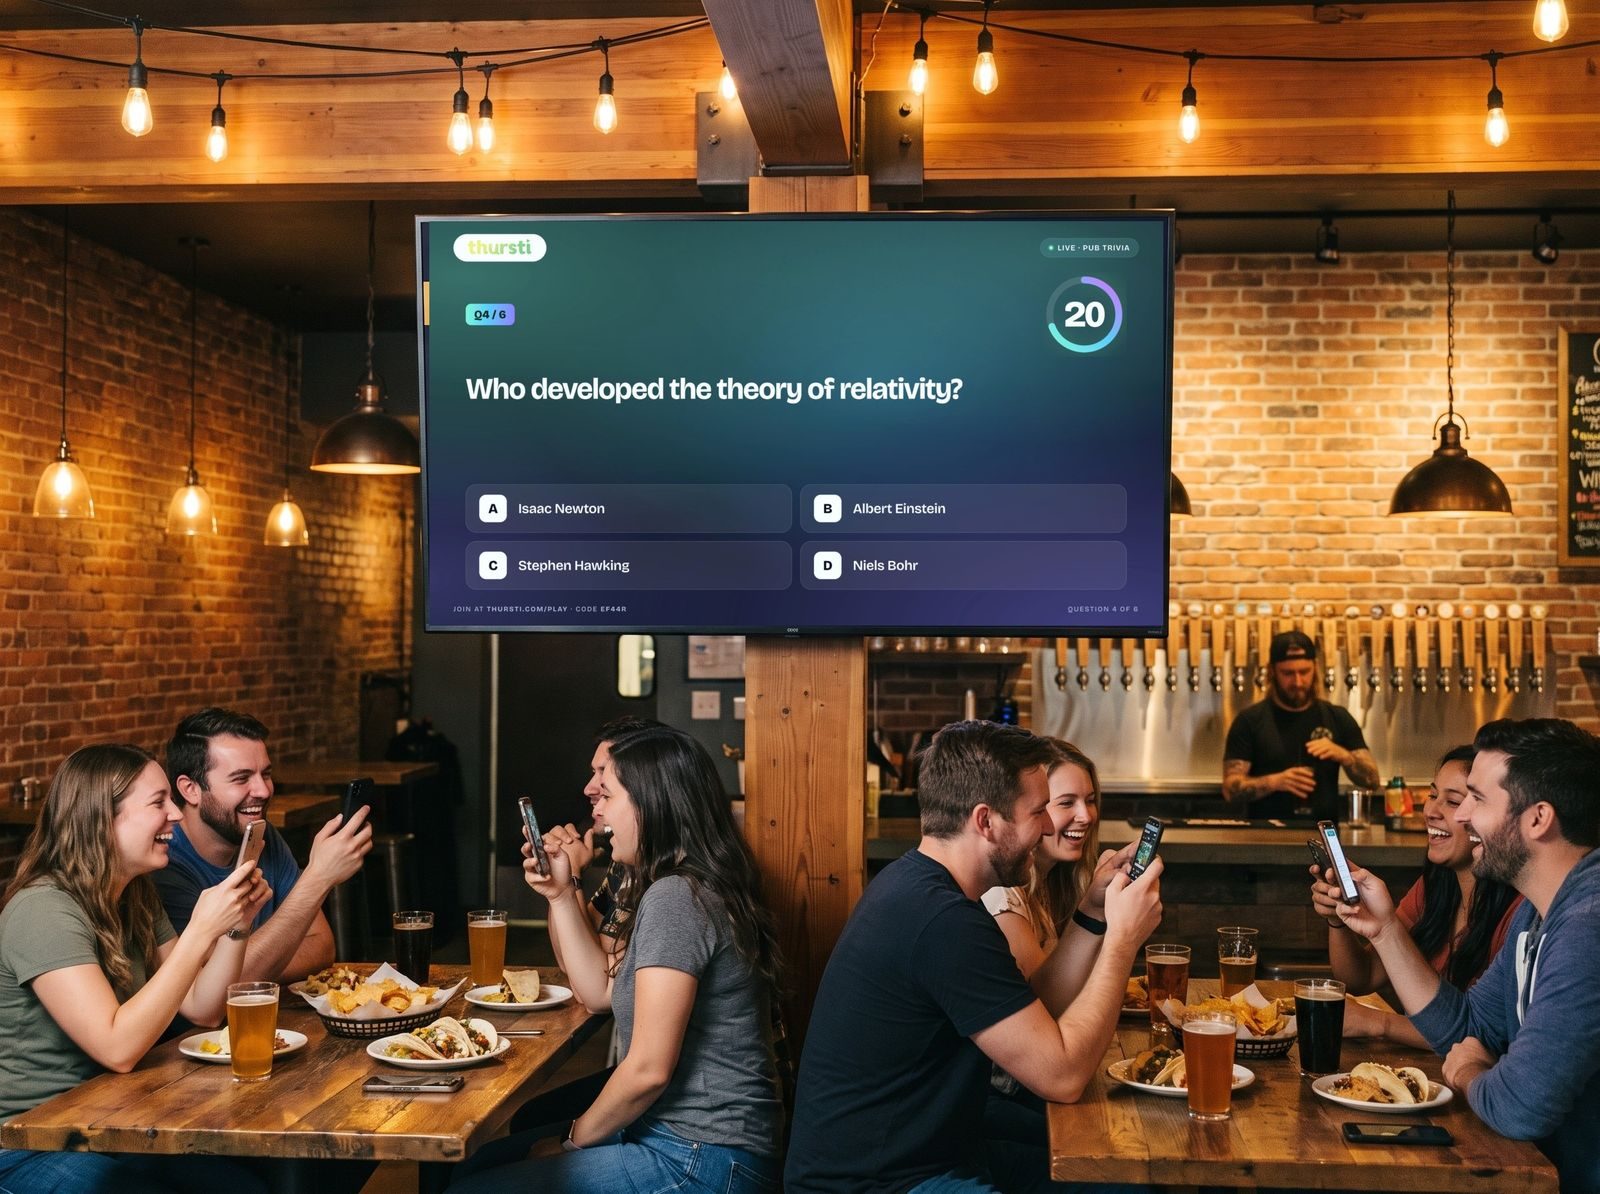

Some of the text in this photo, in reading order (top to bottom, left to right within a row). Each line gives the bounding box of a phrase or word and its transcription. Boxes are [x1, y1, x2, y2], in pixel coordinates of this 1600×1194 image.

[467, 238, 532, 255] thursti
[1057, 244, 1130, 252] LIVE PUB TRIVIA
[474, 310, 490, 321] Q4
[499, 310, 507, 320] 6
[1064, 301, 1106, 328] 20
[466, 376, 963, 405] Who developed the theory of relativity?
[488, 503, 605, 515] A Isaac Newton
[823, 502, 946, 515] B Albert Einstein
[488, 559, 630, 574] C Stephen Hawking
[823, 559, 918, 572] D Niels Bohr
[453, 605, 627, 613] JOIN AT THURSTI.COM/PLAY CODE EF44R
[1067, 605, 1139, 614] QUESTION 4 OF 6
